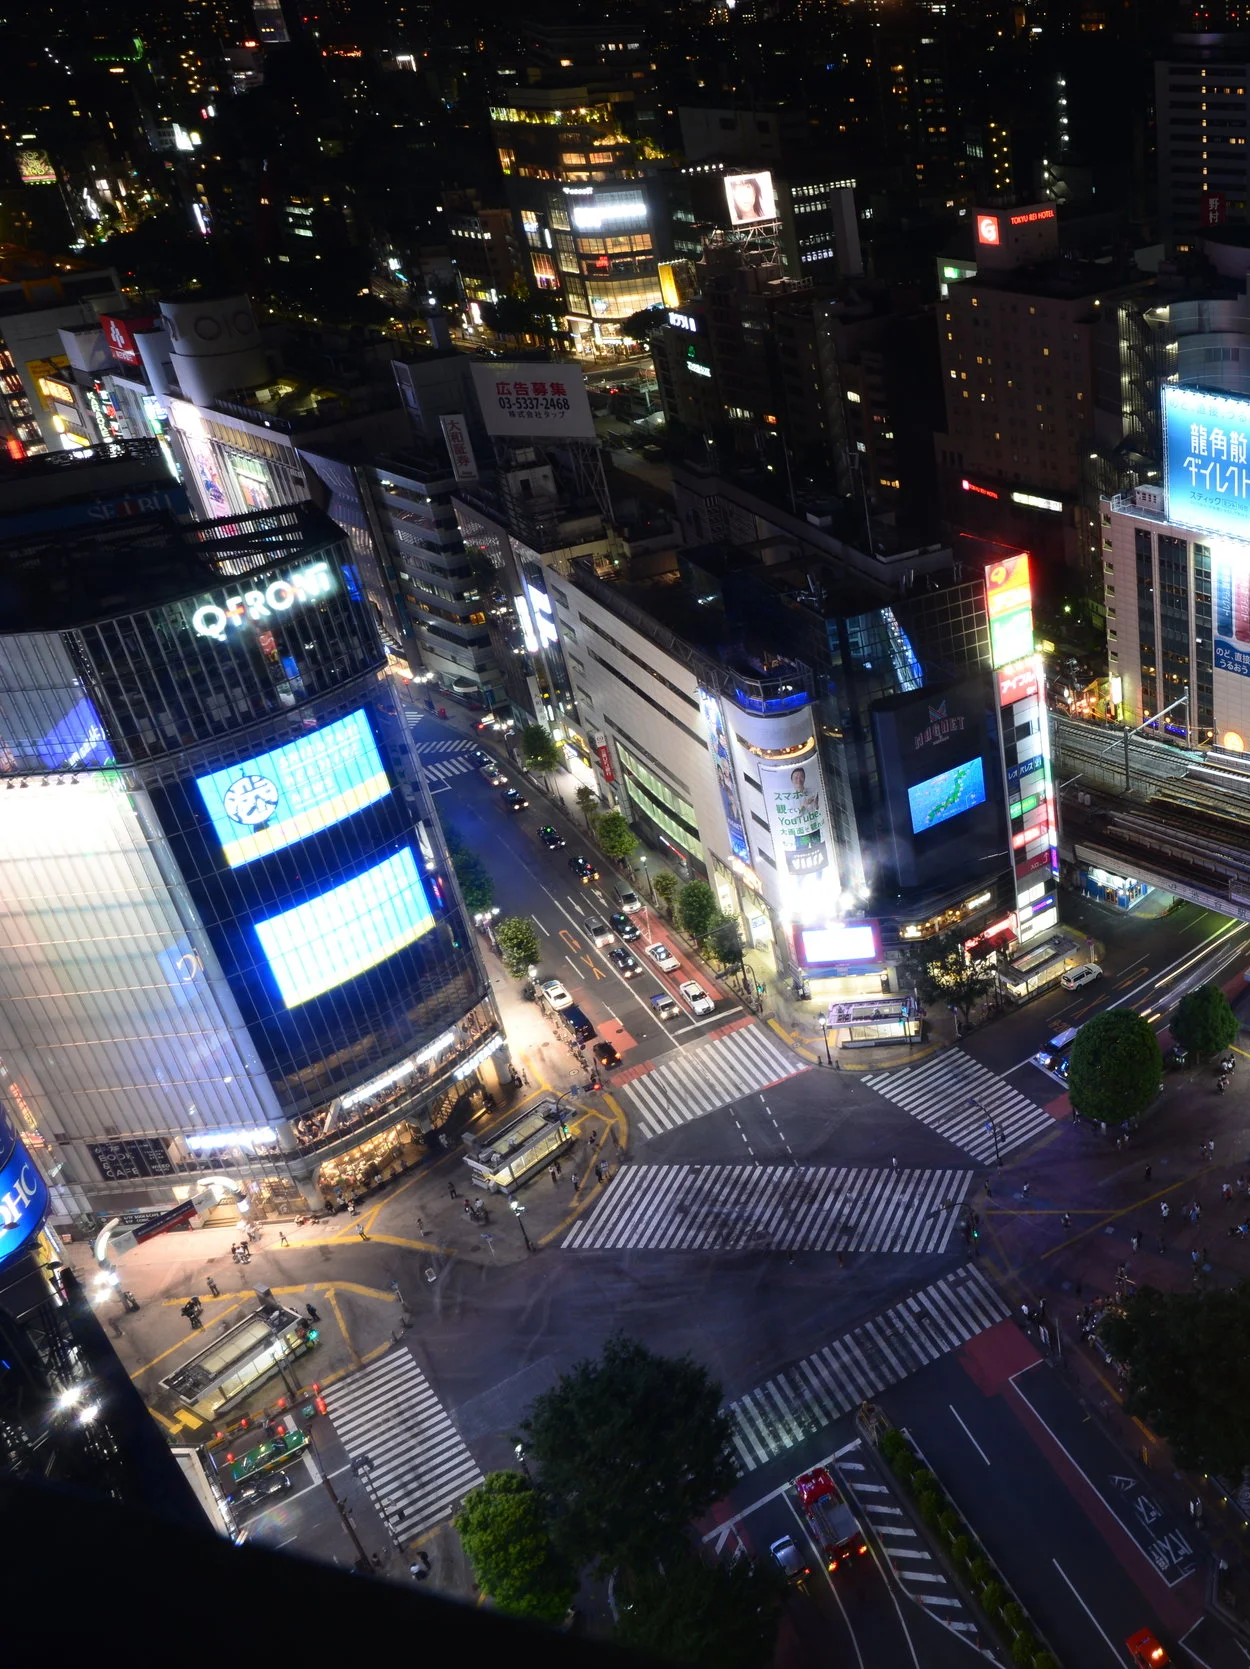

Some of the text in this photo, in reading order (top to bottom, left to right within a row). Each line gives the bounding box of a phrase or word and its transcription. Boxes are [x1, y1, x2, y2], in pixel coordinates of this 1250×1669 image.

[1010, 215, 1028, 225] TOKYU
[1038, 209, 1054, 219] HOTEL
[495, 381, 568, 397] 広告募集
[499, 397, 570, 411] 03-5337-2468
[448, 420, 471, 467] 大和証券
[1189, 422, 1248, 465] 龍角散
[192, 562, 332, 641] QFRONT
[1219, 659, 1249, 675] うるおう
[1001, 671, 1036, 694] アイフル
[914, 716, 965, 750] MAGNET
